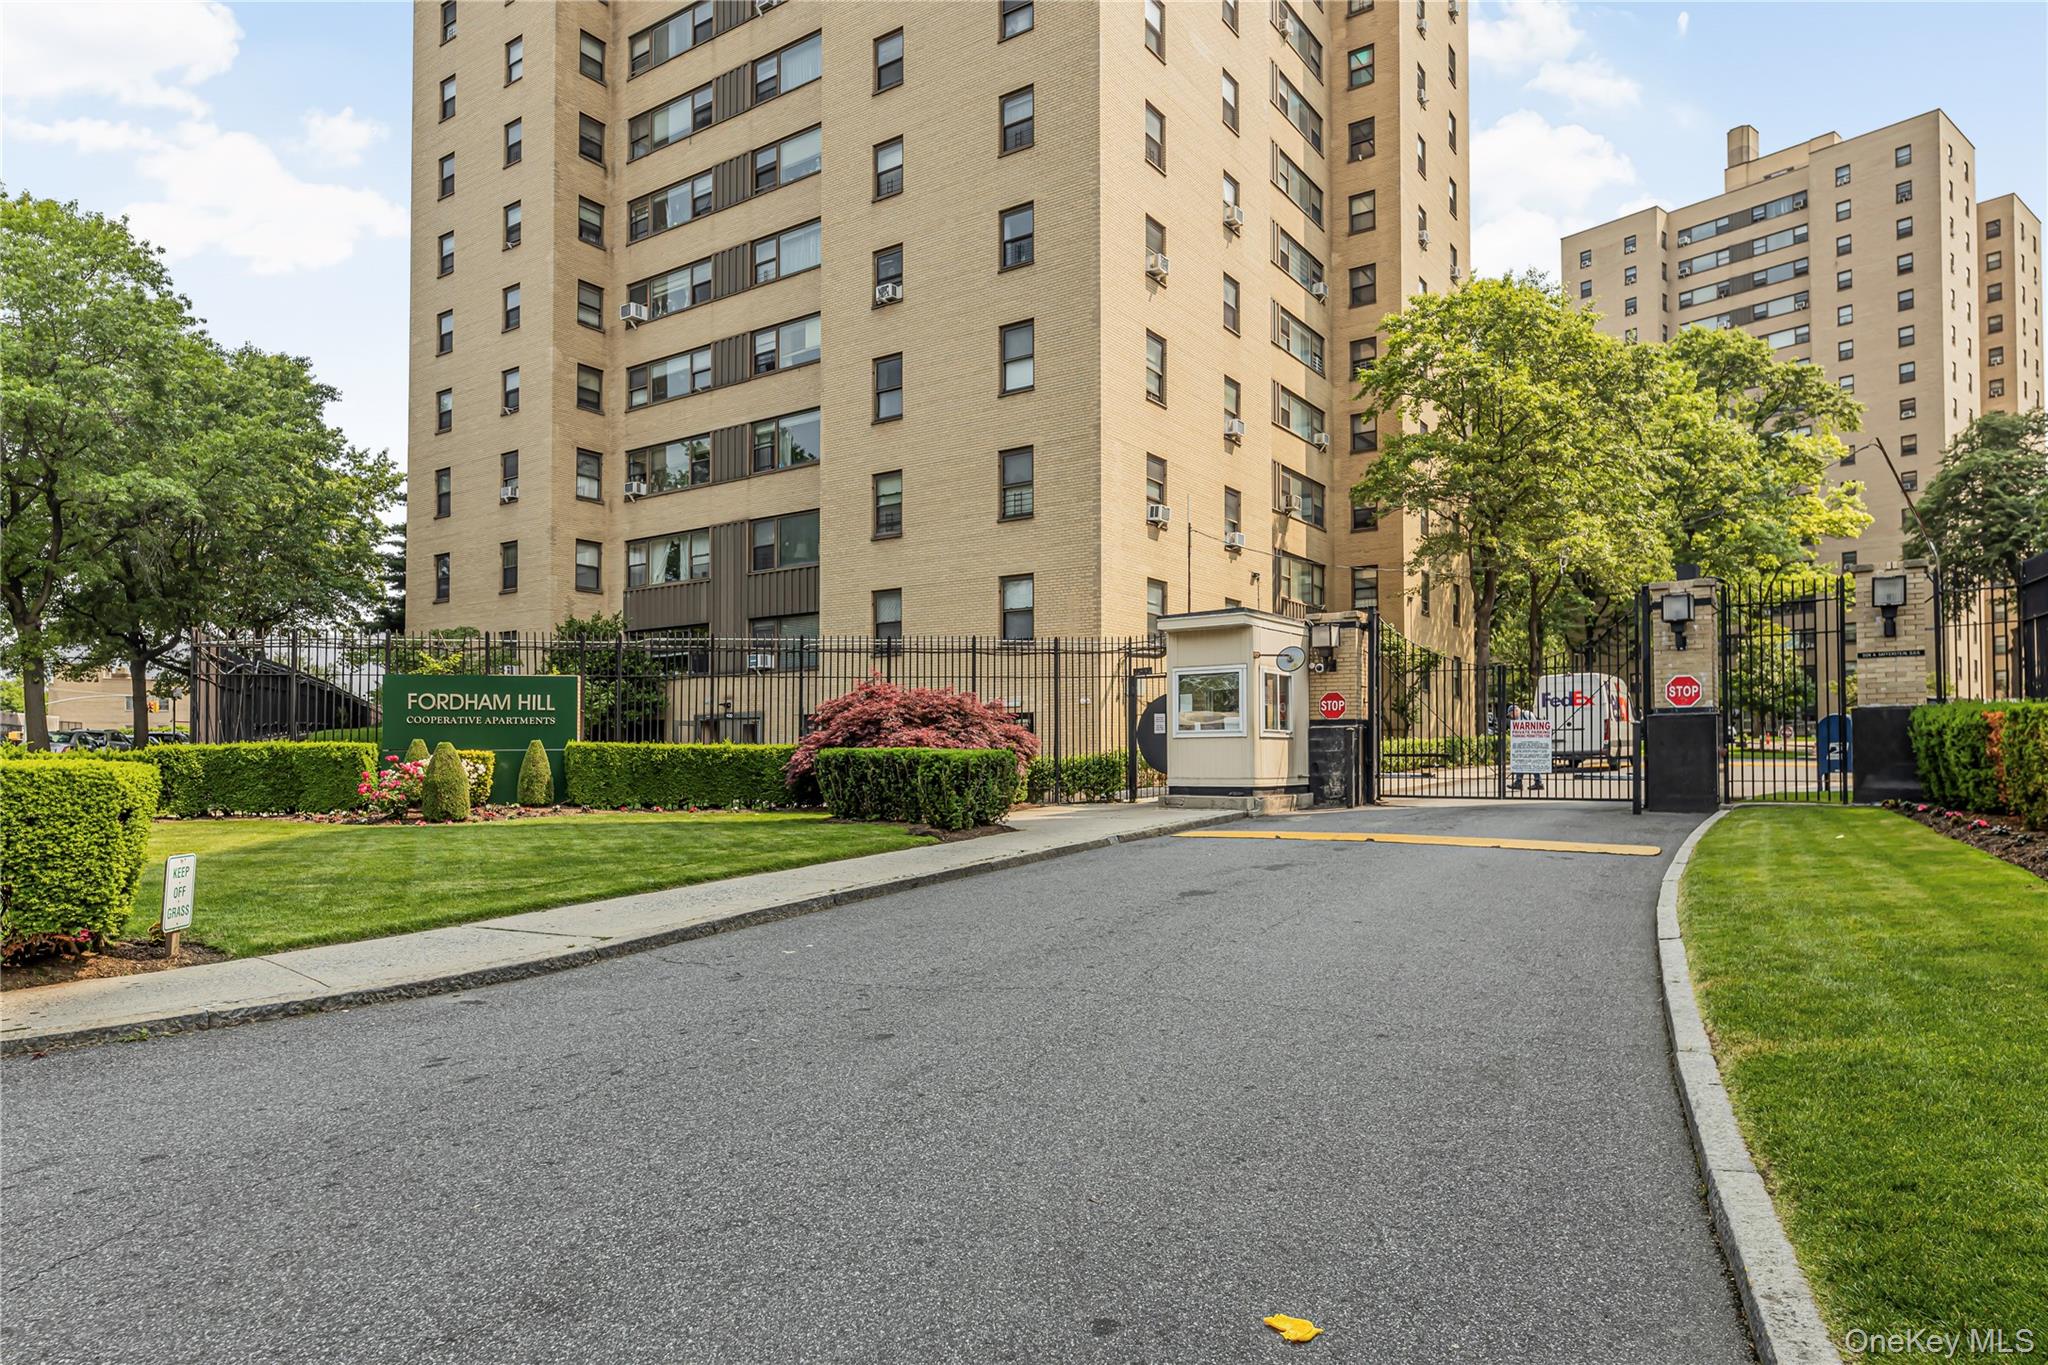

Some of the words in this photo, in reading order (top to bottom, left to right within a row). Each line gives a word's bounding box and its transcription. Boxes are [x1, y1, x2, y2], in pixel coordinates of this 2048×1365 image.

[1669, 685, 1699, 697] STOP
[407, 692, 511, 711] FORDHAM
[518, 693, 556, 711] HILL
[1320, 700, 1345, 711] STOP
[1541, 690, 1596, 708] FedEx
[406, 715, 482, 725] COOPERATIVE
[484, 716, 556, 725] APARTMENTS
[1512, 721, 1551, 730] WARNING
[172, 866, 190, 879] KEEP
[173, 885, 187, 899] OFF
[167, 904, 190, 920] GRASS
